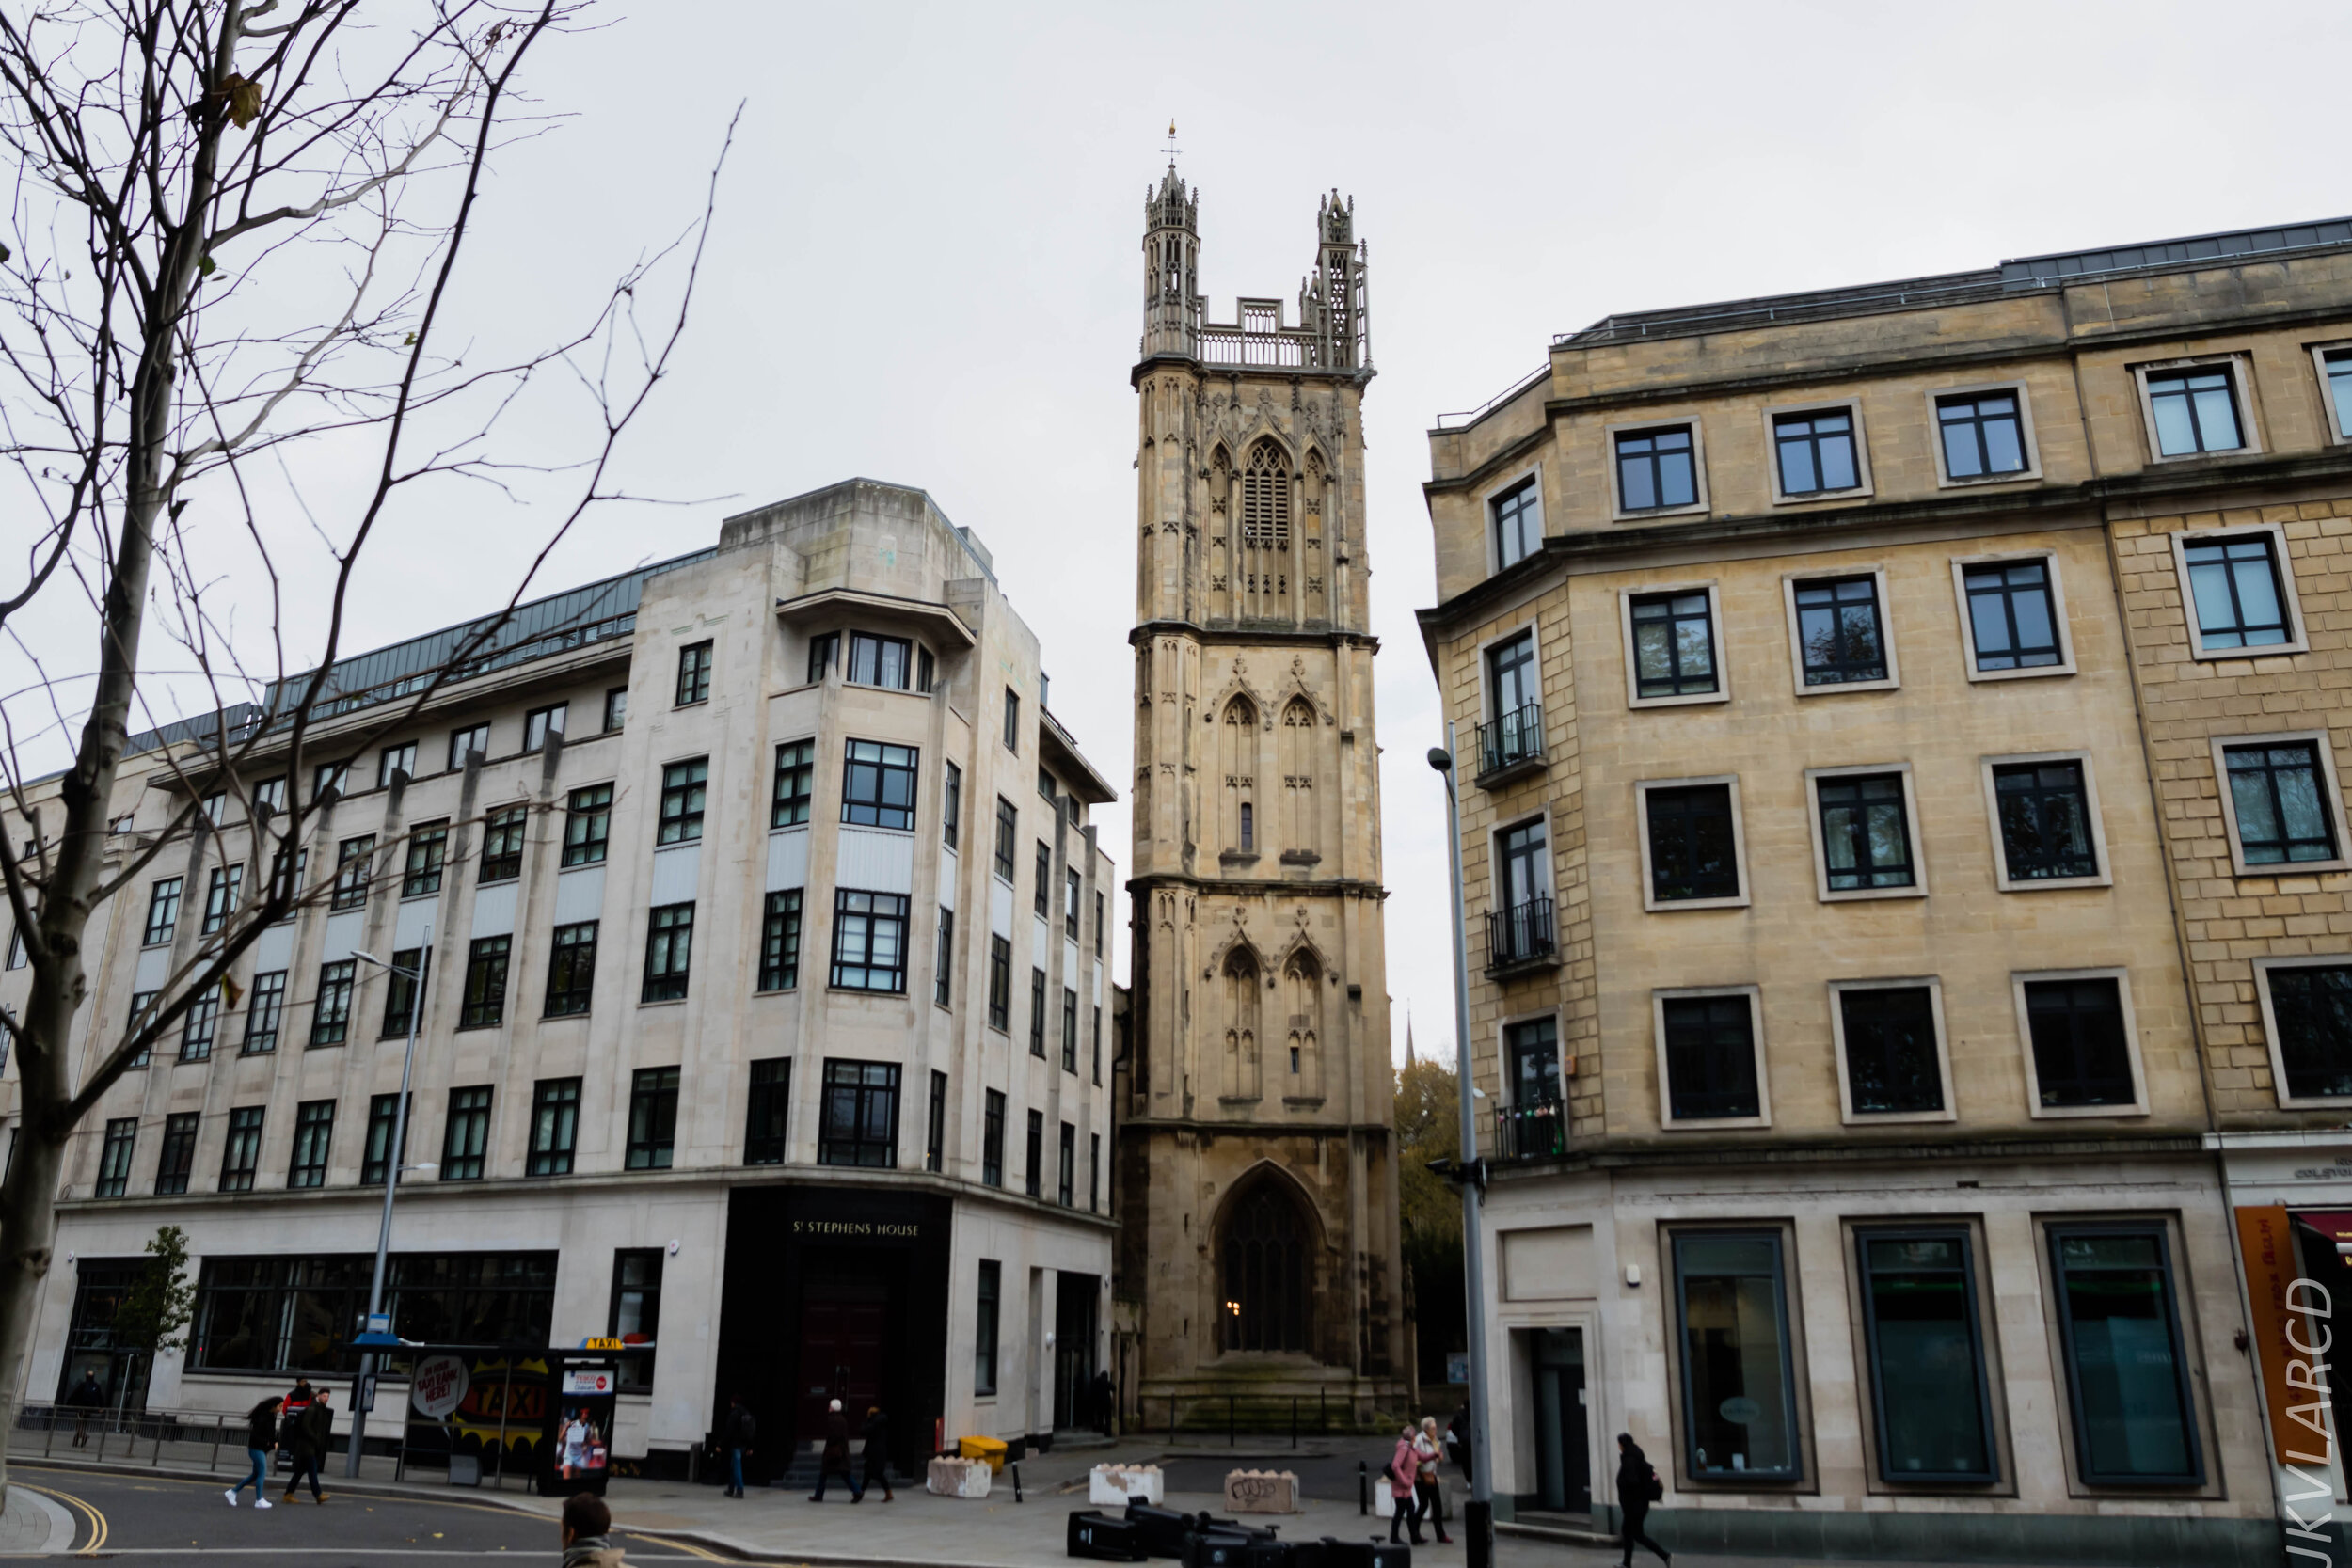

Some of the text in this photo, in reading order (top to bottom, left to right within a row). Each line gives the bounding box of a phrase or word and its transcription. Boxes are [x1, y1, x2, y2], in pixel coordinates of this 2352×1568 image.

[877, 1224, 919, 1236] HOUSE
[593, 1338, 617, 1348] TAXI
[417, 1369, 458, 1392] TAXI RANK
[425, 1384, 451, 1402] HERE!
[474, 1385, 540, 1415] TAXI
